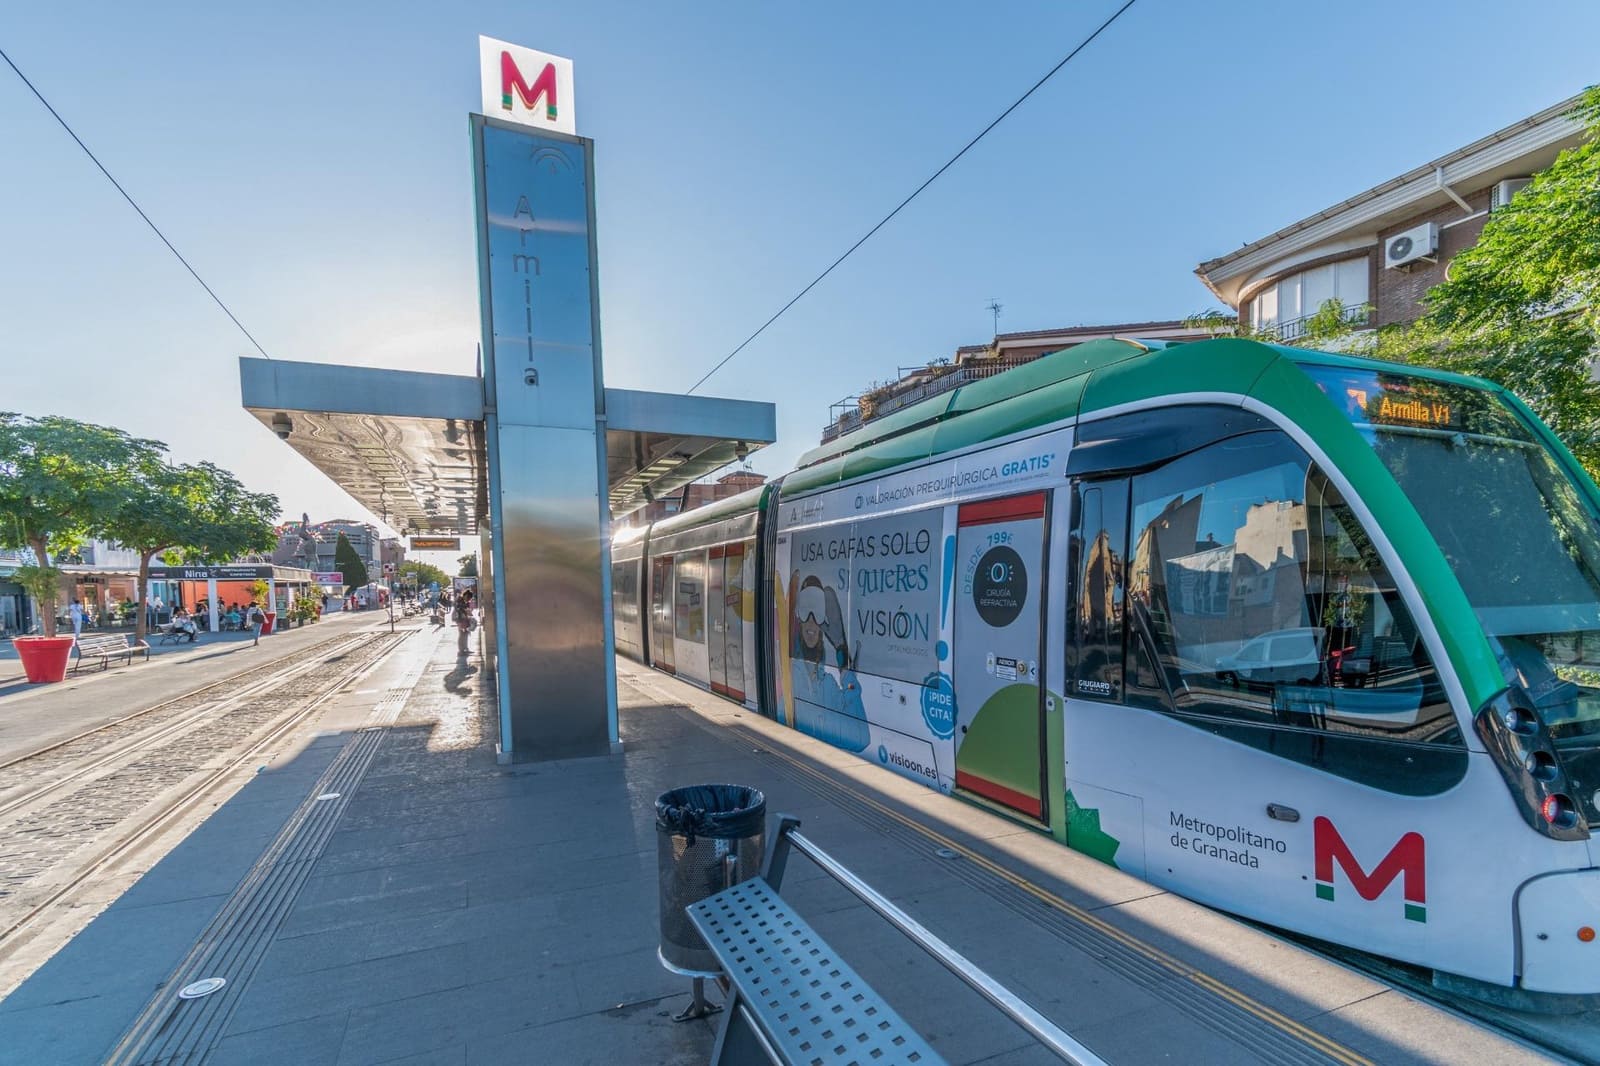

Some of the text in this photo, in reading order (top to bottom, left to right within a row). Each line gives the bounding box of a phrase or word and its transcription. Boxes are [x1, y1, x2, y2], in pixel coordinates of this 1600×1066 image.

[501, 50, 557, 121] M
[512, 194, 540, 386] Armilla
[1380, 397, 1450, 424] Armilla V1
[865, 487, 915, 508] VALORACIÓN
[916, 467, 999, 497] PREQUIRÚRGICA
[801, 529, 930, 562] USA GAFAS SOLO
[184, 570, 208, 578] Nina
[889, 752, 937, 779] visioon.es
[1170, 811, 1287, 853] Metropolitano
[1170, 832, 1259, 868] de Granada
[1314, 815, 1426, 923] M
